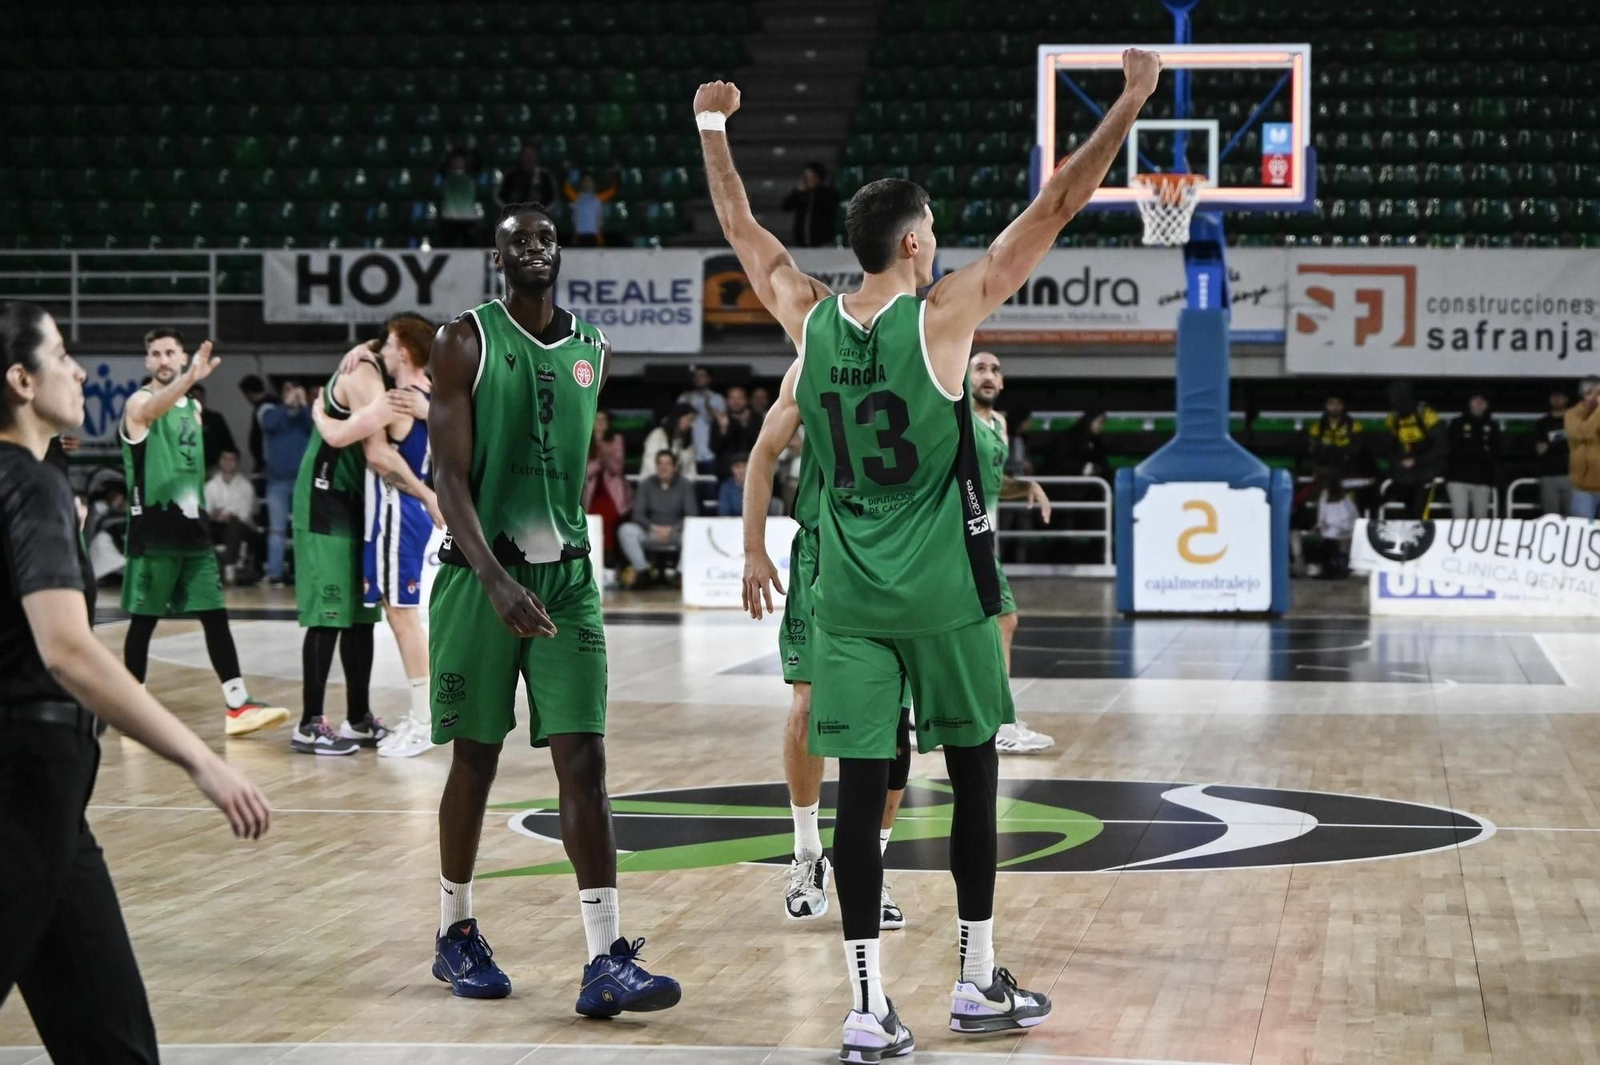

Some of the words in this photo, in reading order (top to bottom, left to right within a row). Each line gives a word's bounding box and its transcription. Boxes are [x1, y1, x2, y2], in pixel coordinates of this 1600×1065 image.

[297, 253, 450, 307] HOY
[567, 279, 693, 305] REALE
[1426, 294, 1595, 316] construcciones
[1427, 320, 1594, 361] safranja
[538, 388, 555, 425] 3
[820, 390, 919, 489] 13
[1144, 575, 1261, 595] cajalmendralejo
[1525, 569, 1599, 597] DENTAL
[437, 690, 467, 700] TOYOTA
